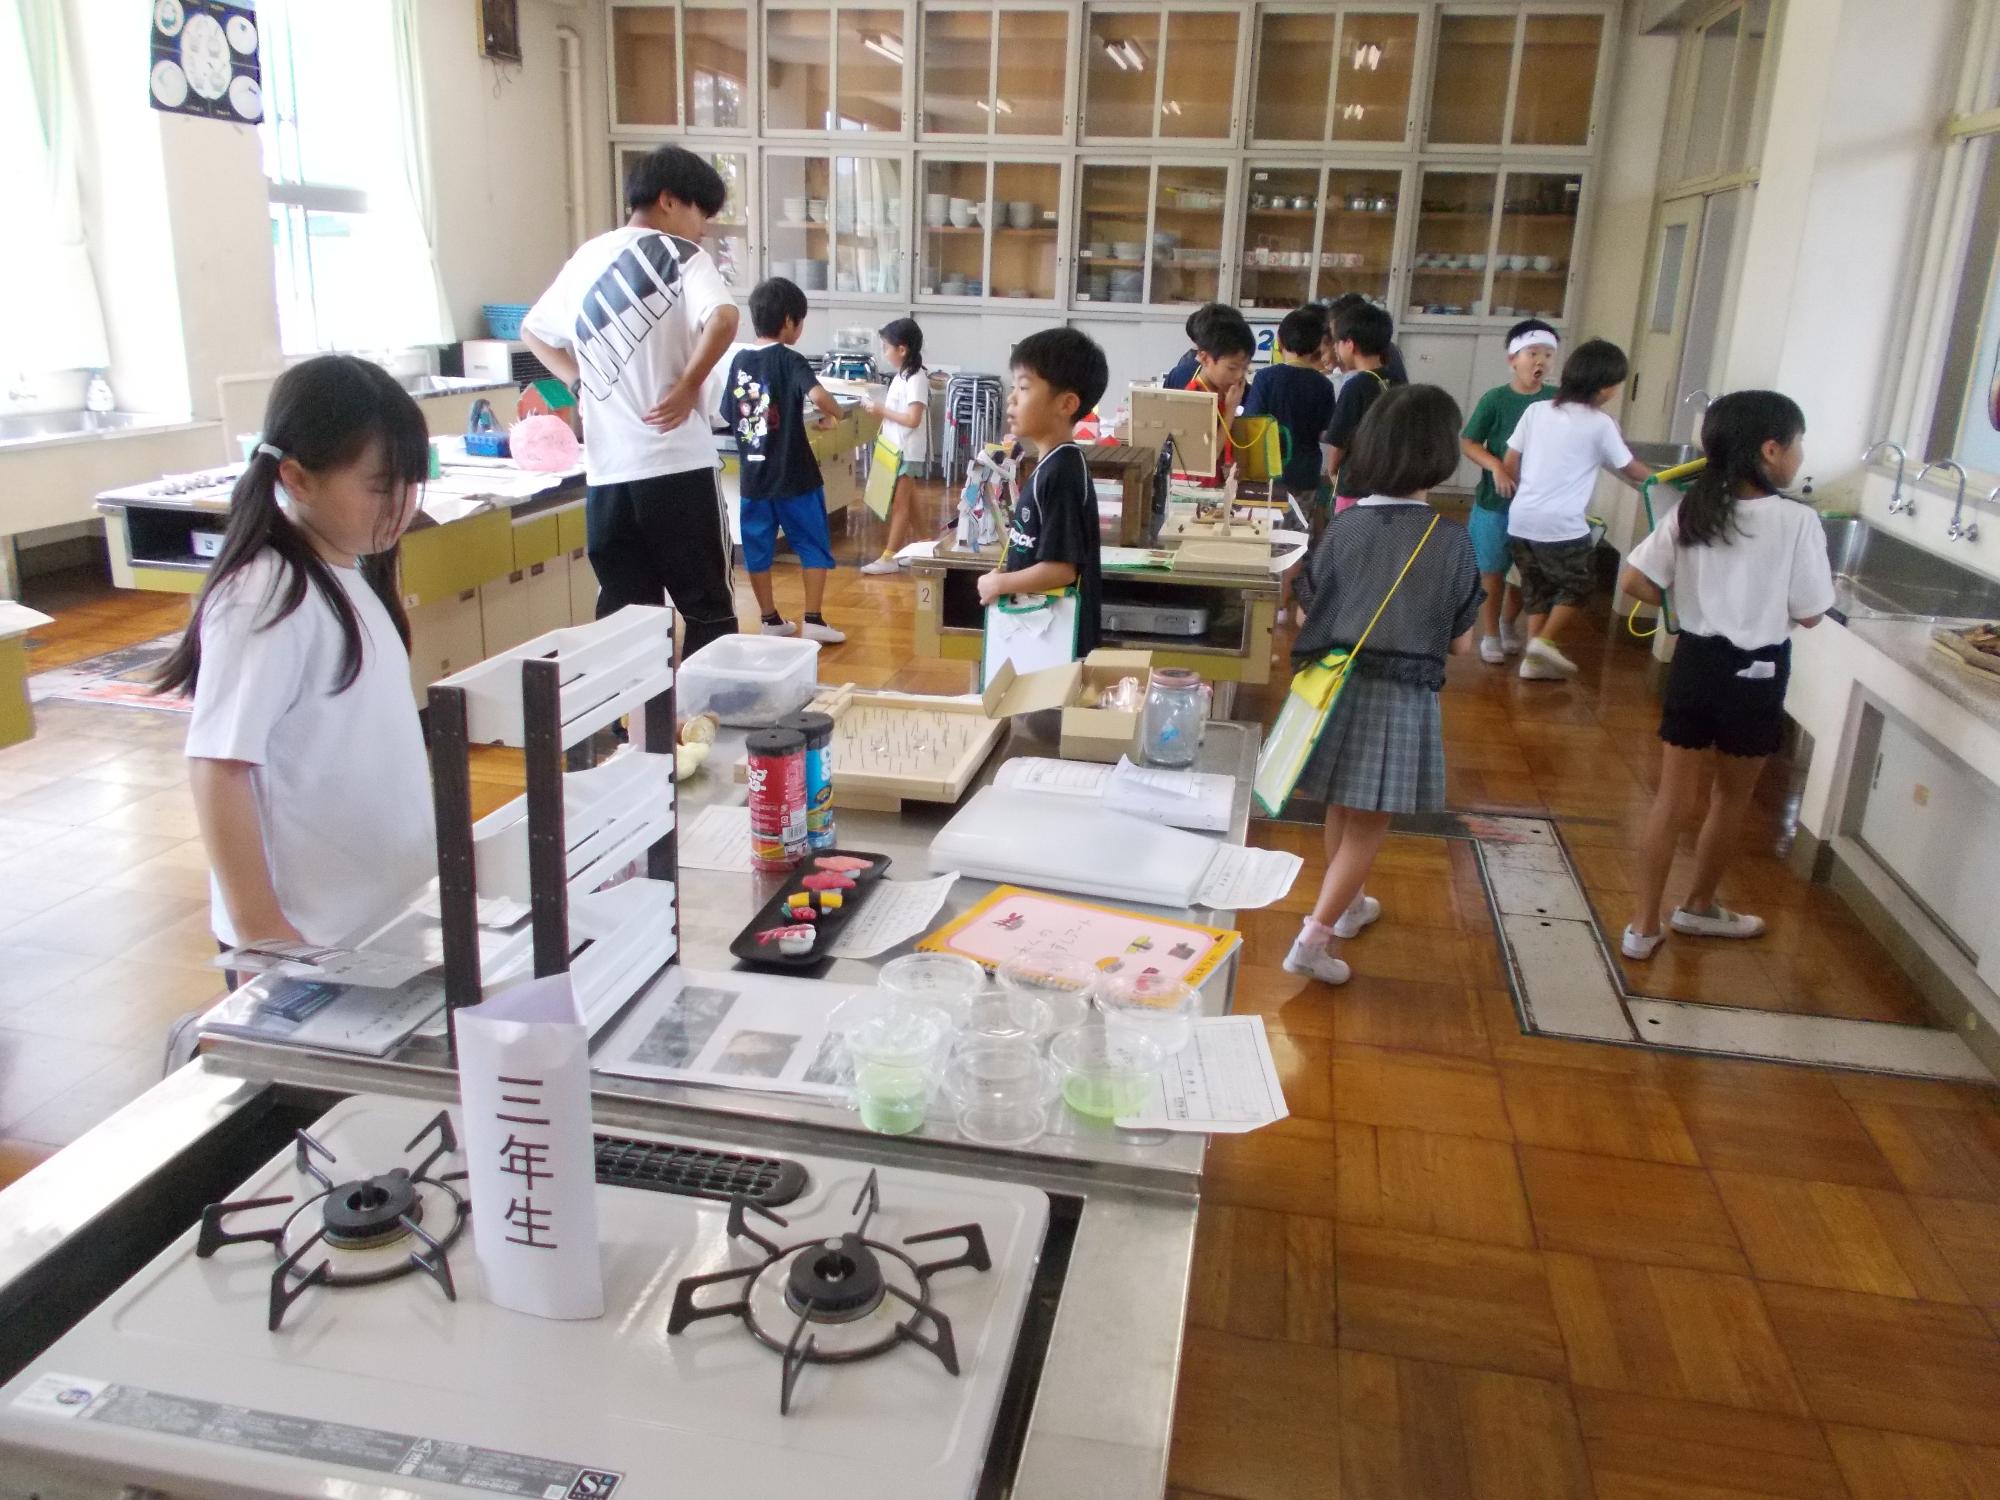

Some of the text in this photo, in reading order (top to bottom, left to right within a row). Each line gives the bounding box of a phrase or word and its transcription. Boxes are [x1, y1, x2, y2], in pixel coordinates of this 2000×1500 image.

[1258, 329, 1275, 351] 2
[921, 586, 931, 604] 2
[496, 1075, 558, 1249] 三年生
